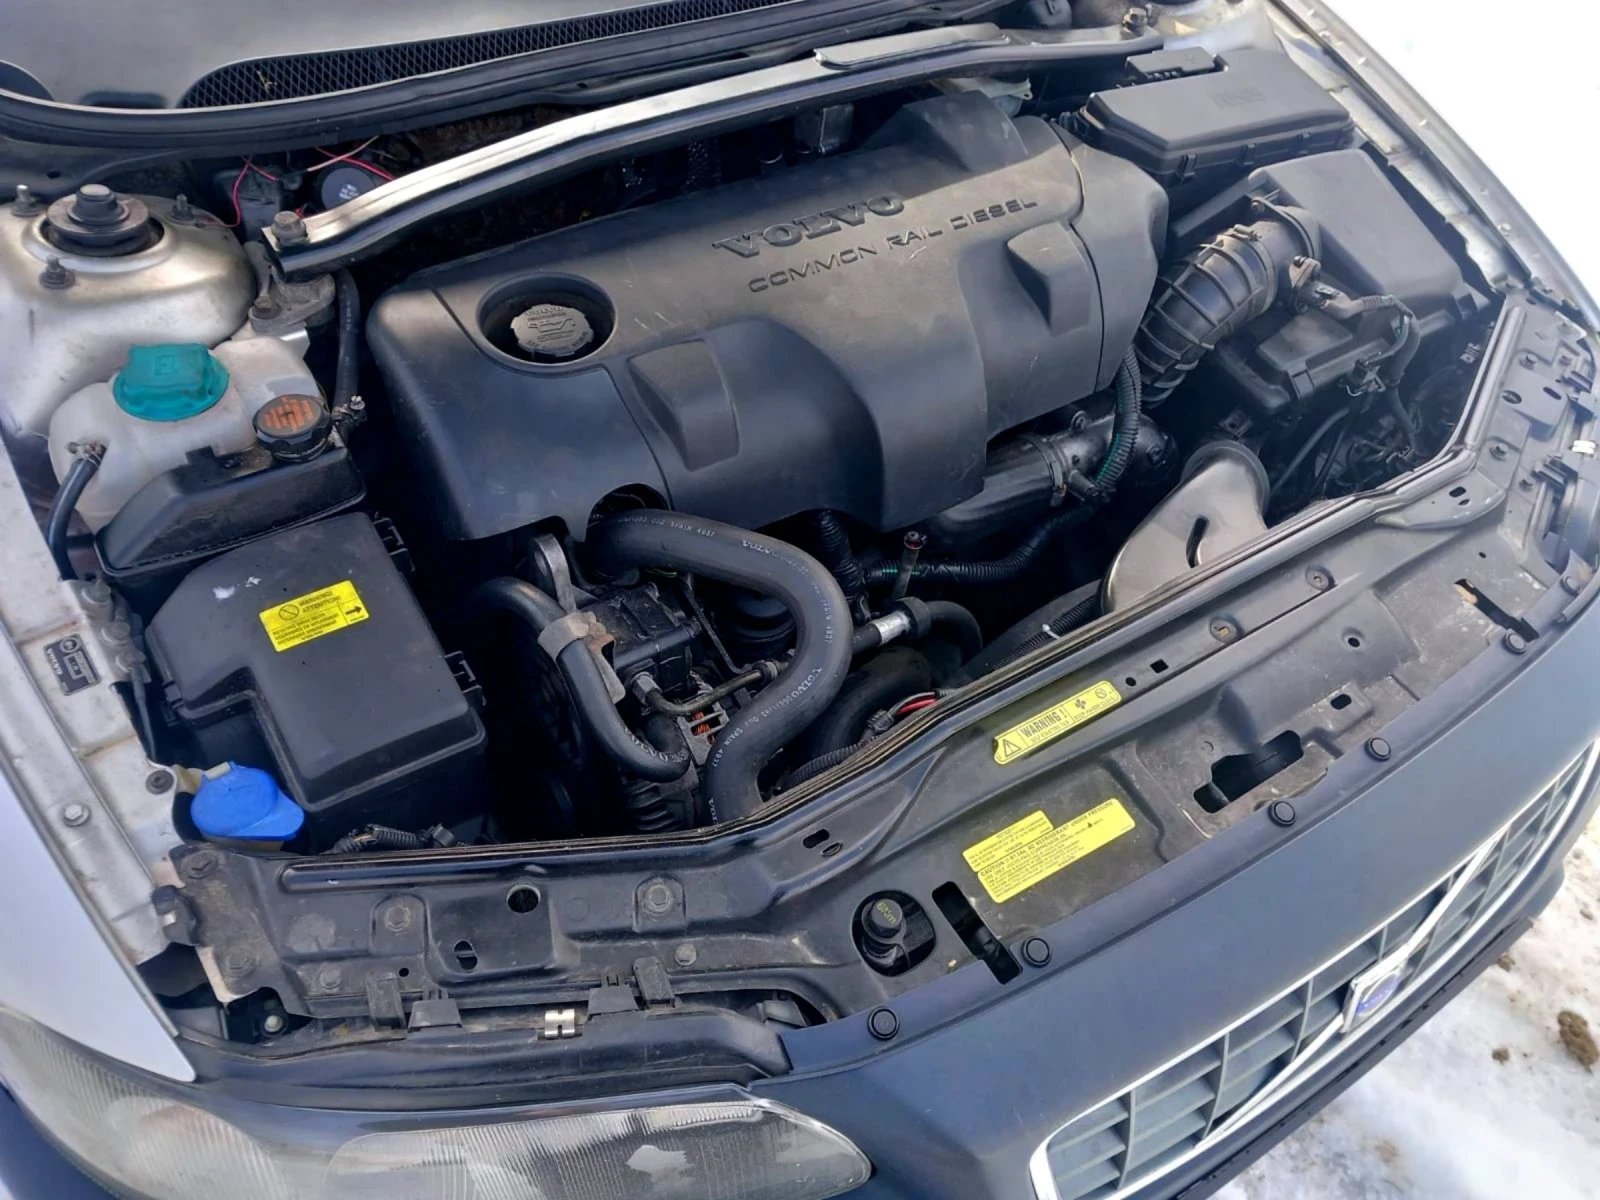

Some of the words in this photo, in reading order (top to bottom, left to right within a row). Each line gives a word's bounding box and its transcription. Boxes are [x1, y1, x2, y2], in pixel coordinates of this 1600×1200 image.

[712, 194, 905, 258] VOLVO
[747, 243, 878, 293] COMMON
[885, 225, 943, 250] RAIL
[949, 198, 1038, 241] DIESEL
[792, 667, 822, 699] VOLVO
[724, 727, 744, 747] SPAIN
[1020, 711, 1061, 738] WARNING
[624, 727, 667, 762] VOLVO
[979, 859, 1005, 877] CAUTION
